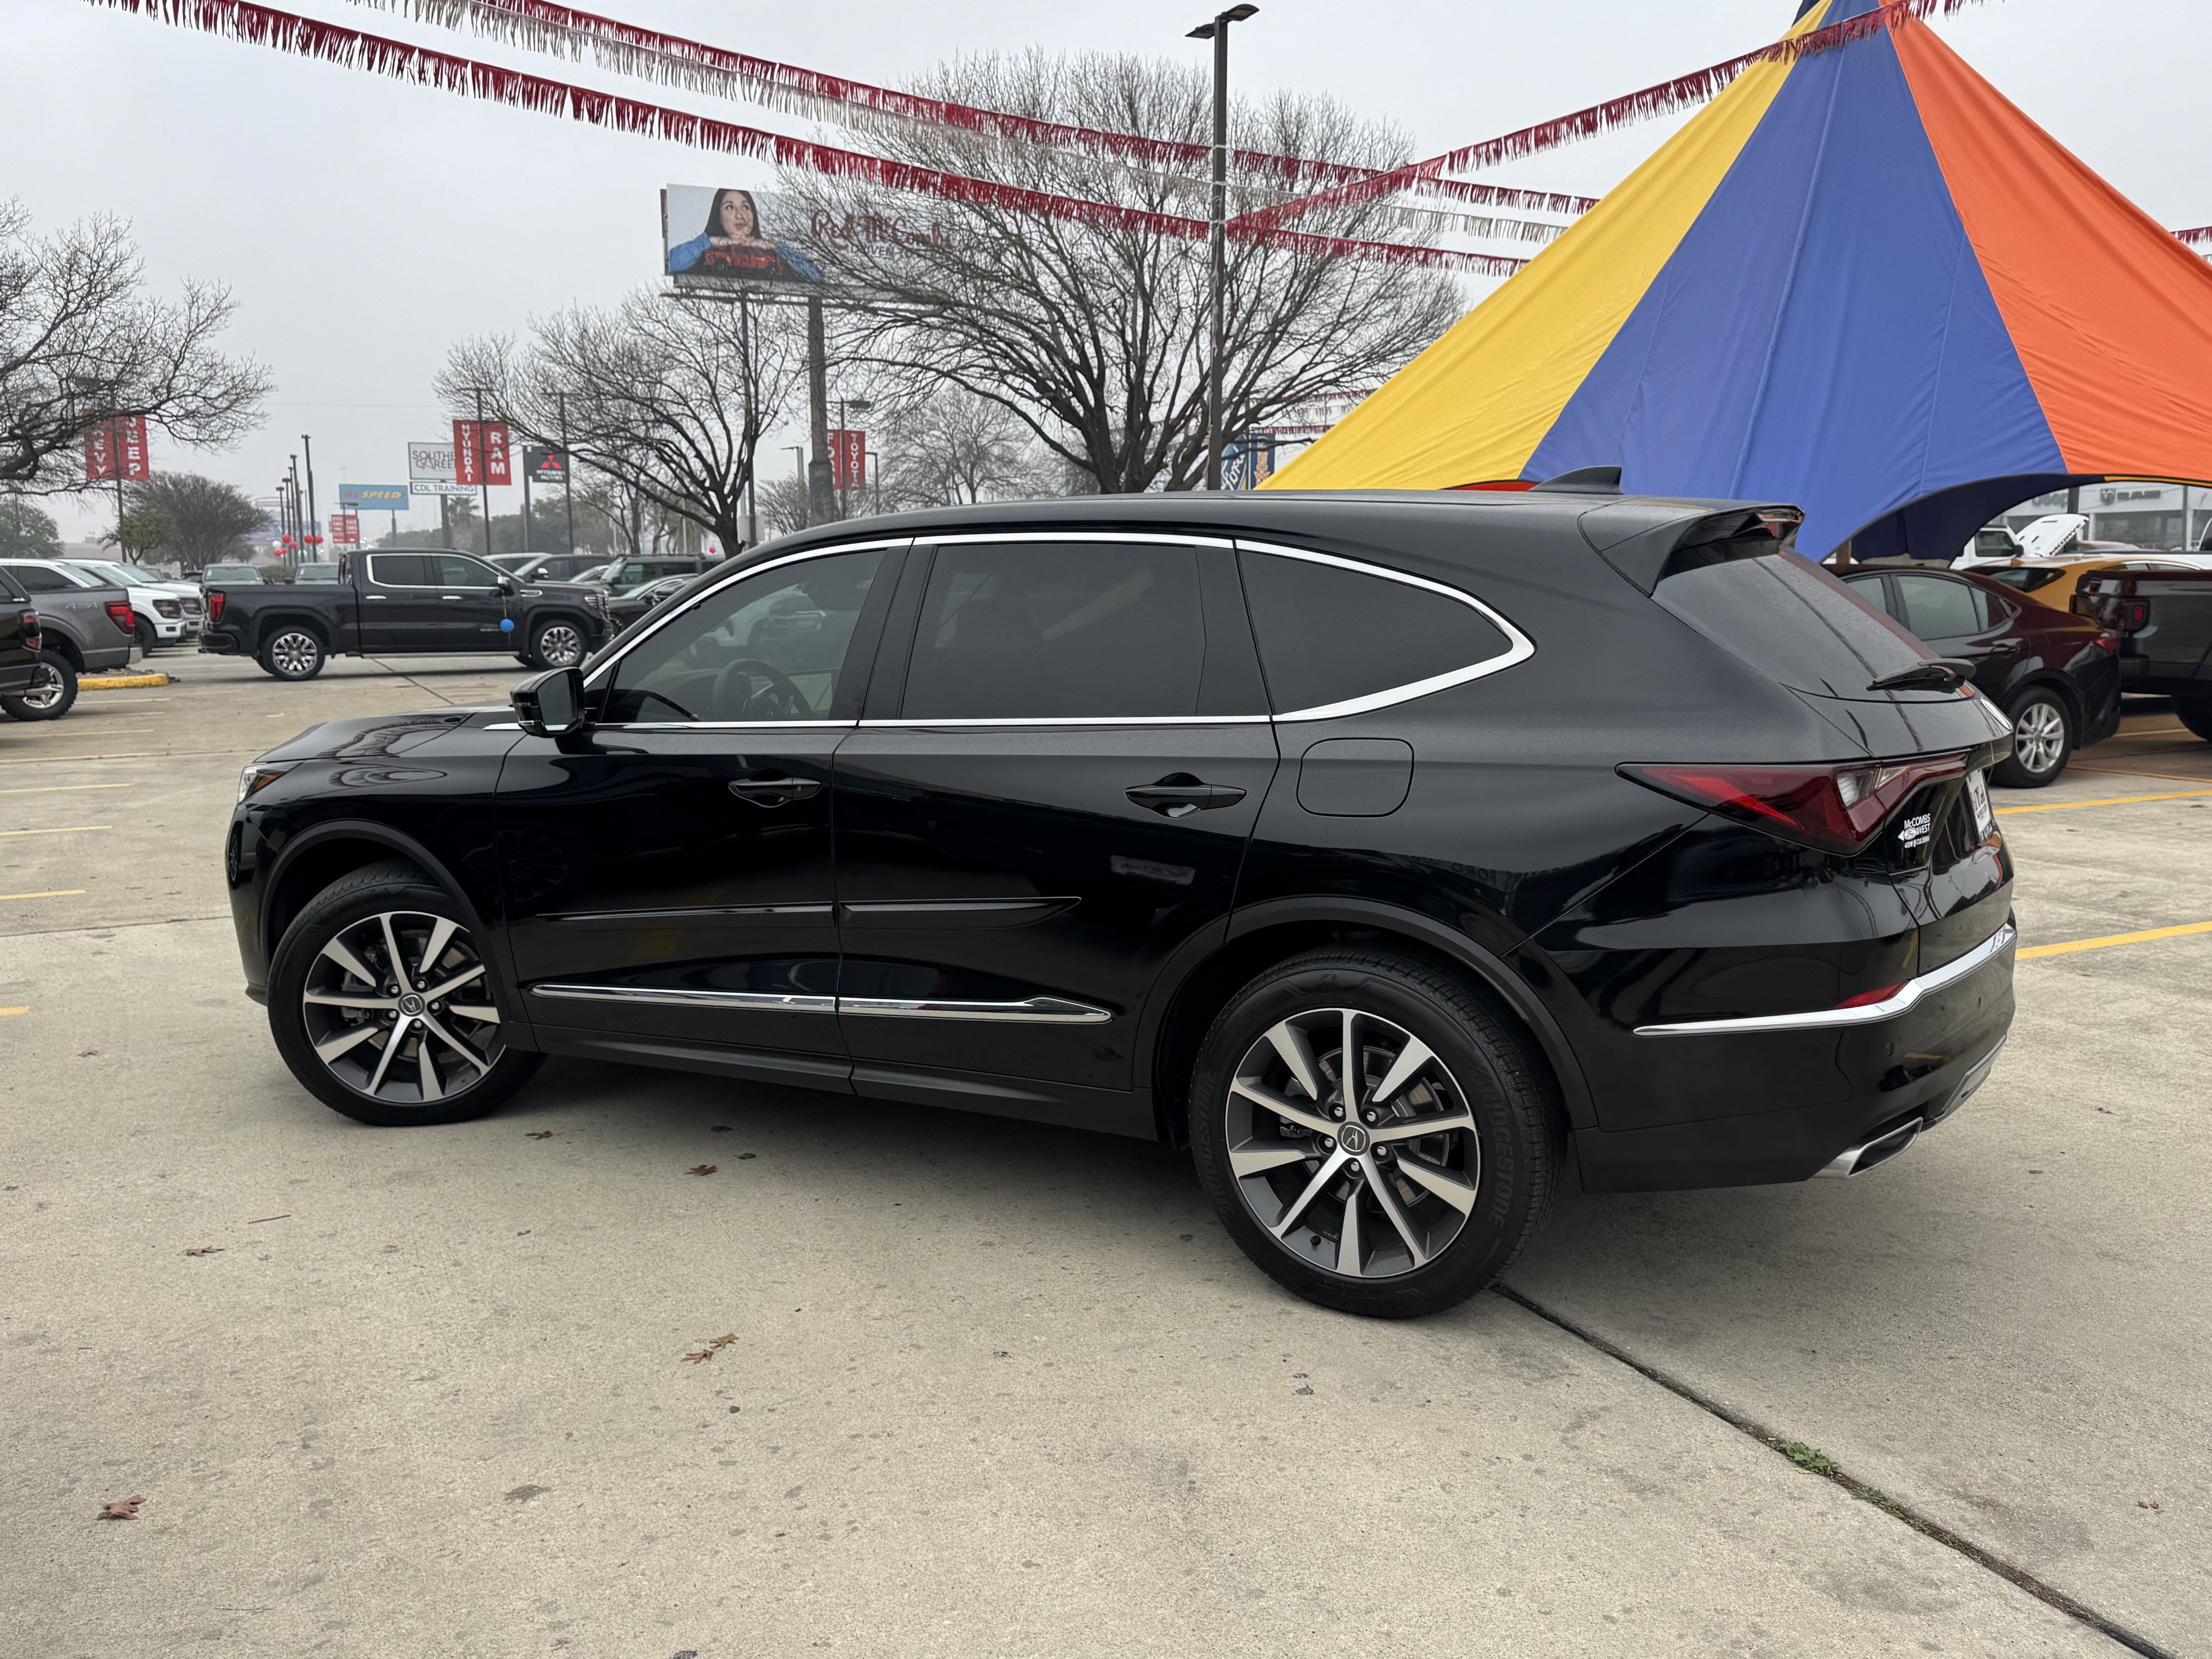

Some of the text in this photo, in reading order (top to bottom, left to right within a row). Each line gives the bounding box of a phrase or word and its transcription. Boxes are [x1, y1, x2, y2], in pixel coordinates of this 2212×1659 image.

[412, 450, 455, 460] SOUTHE
[416, 459, 455, 469] CAREE
[462, 424, 473, 482] HYUNDAI
[490, 431, 505, 475] RAM
[850, 433, 859, 488] TOYOTA
[361, 491, 403, 499] SPEED
